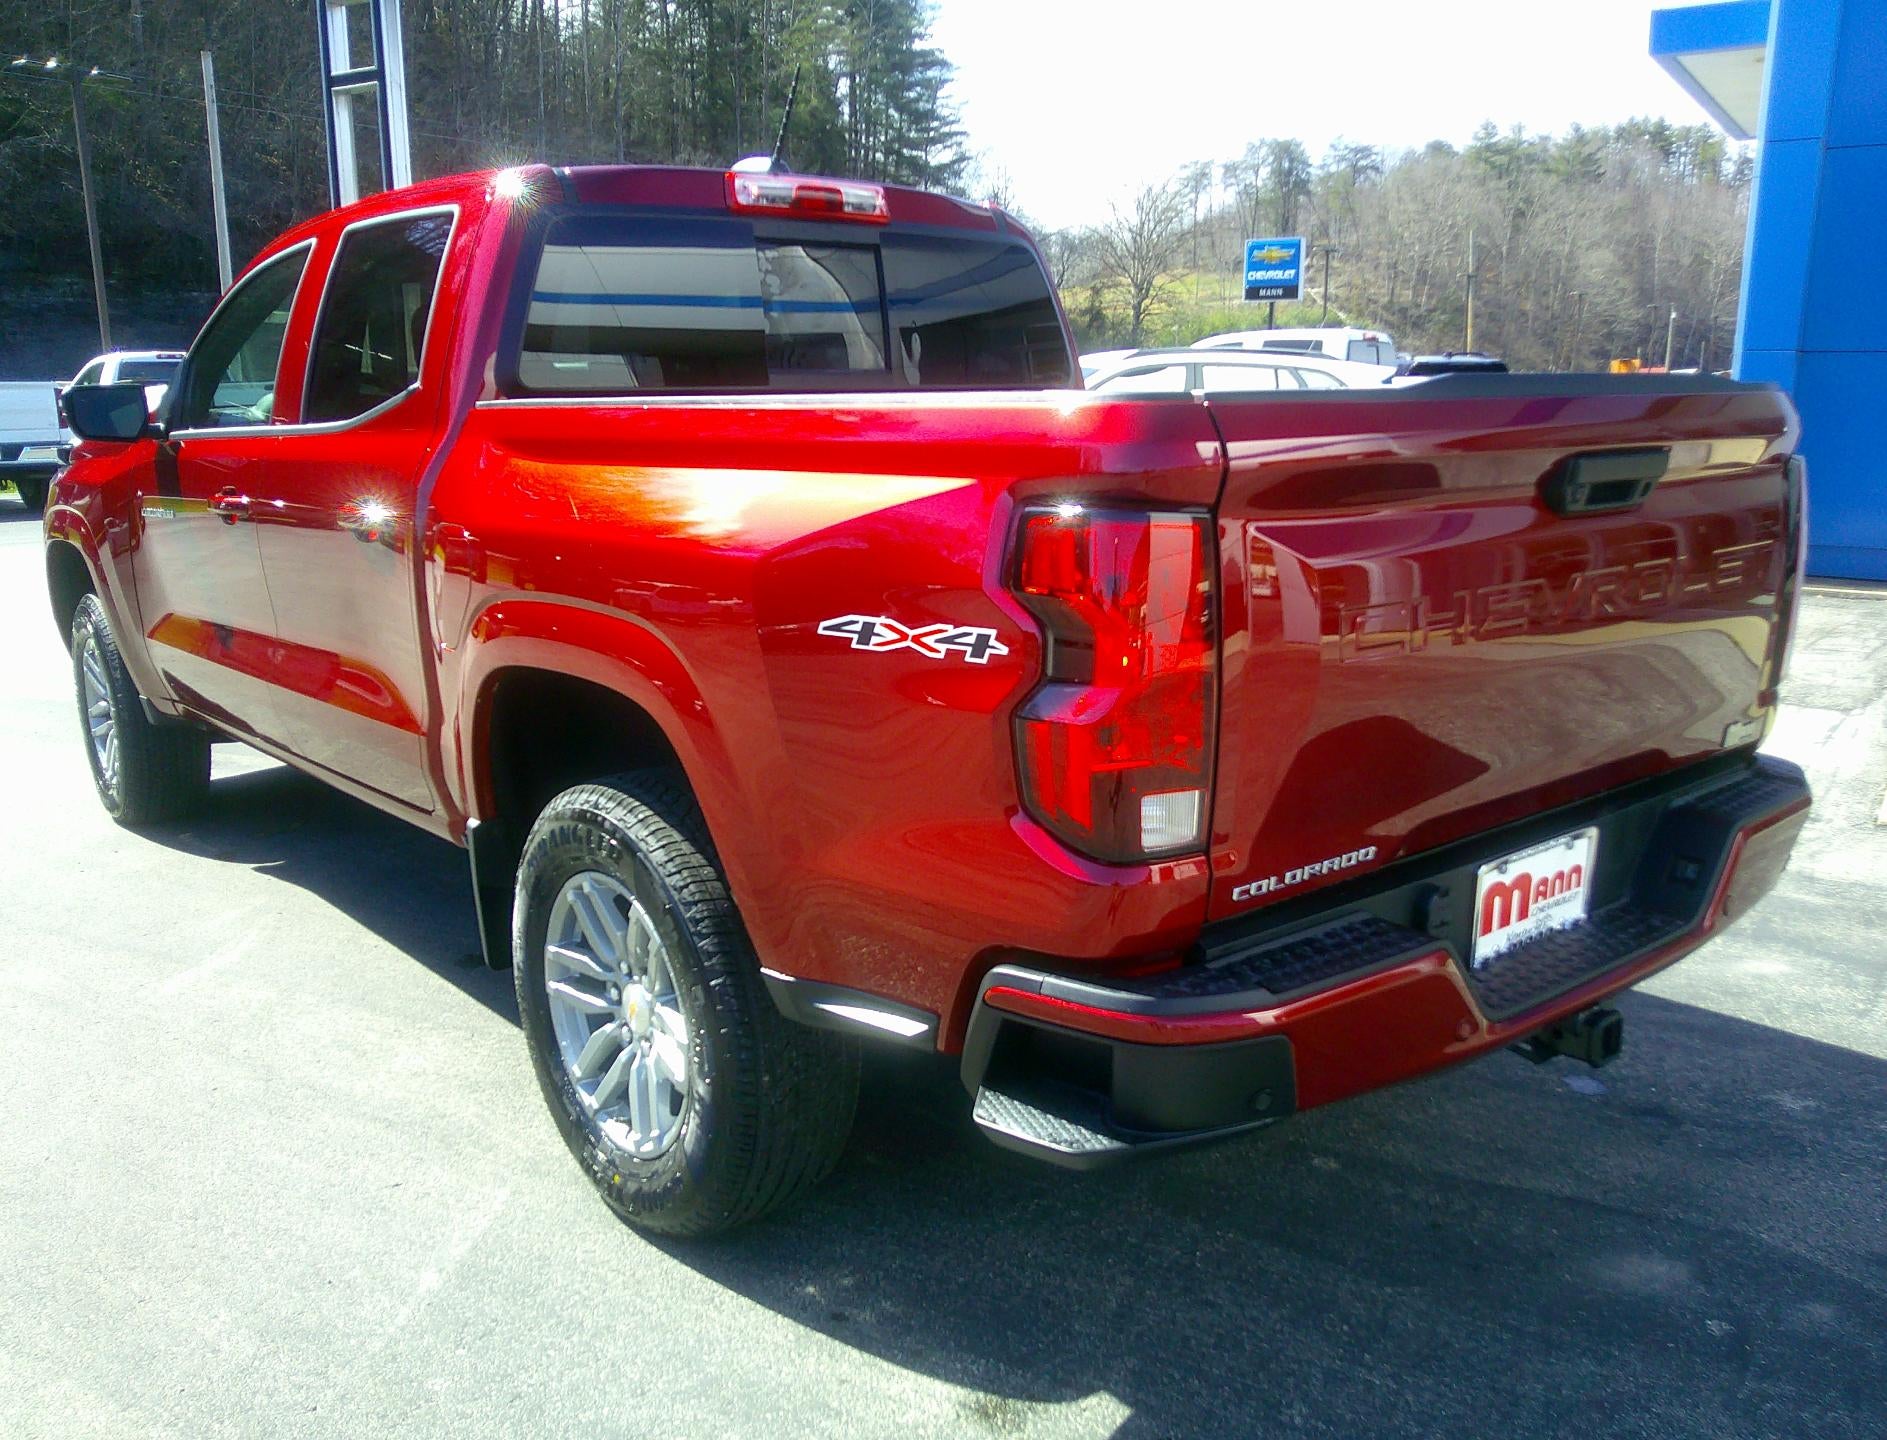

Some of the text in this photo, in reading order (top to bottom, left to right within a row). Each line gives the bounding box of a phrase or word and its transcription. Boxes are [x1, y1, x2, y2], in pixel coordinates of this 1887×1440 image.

[1247, 269, 1296, 281] CHEVROLET
[1259, 287, 1284, 297] MANN
[1232, 845, 1378, 902] COLORADO
